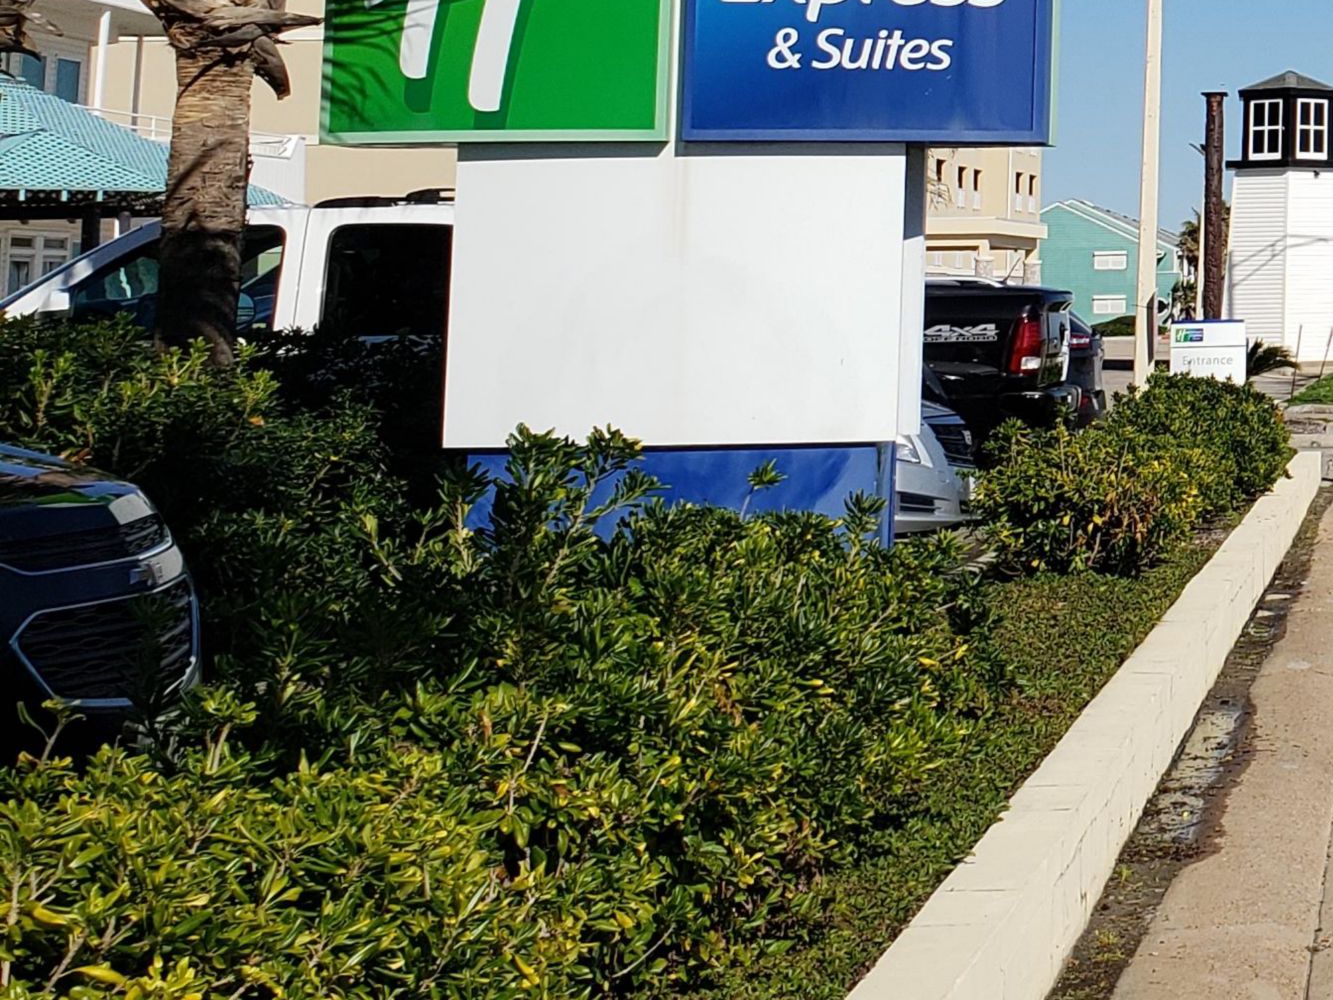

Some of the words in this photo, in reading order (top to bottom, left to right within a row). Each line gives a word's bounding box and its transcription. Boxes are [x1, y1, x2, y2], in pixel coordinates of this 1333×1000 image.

[766, 27, 803, 70] &
[810, 27, 953, 72] Suites
[923, 323, 1000, 337] 4x4
[1182, 354, 1234, 367] Entrance
